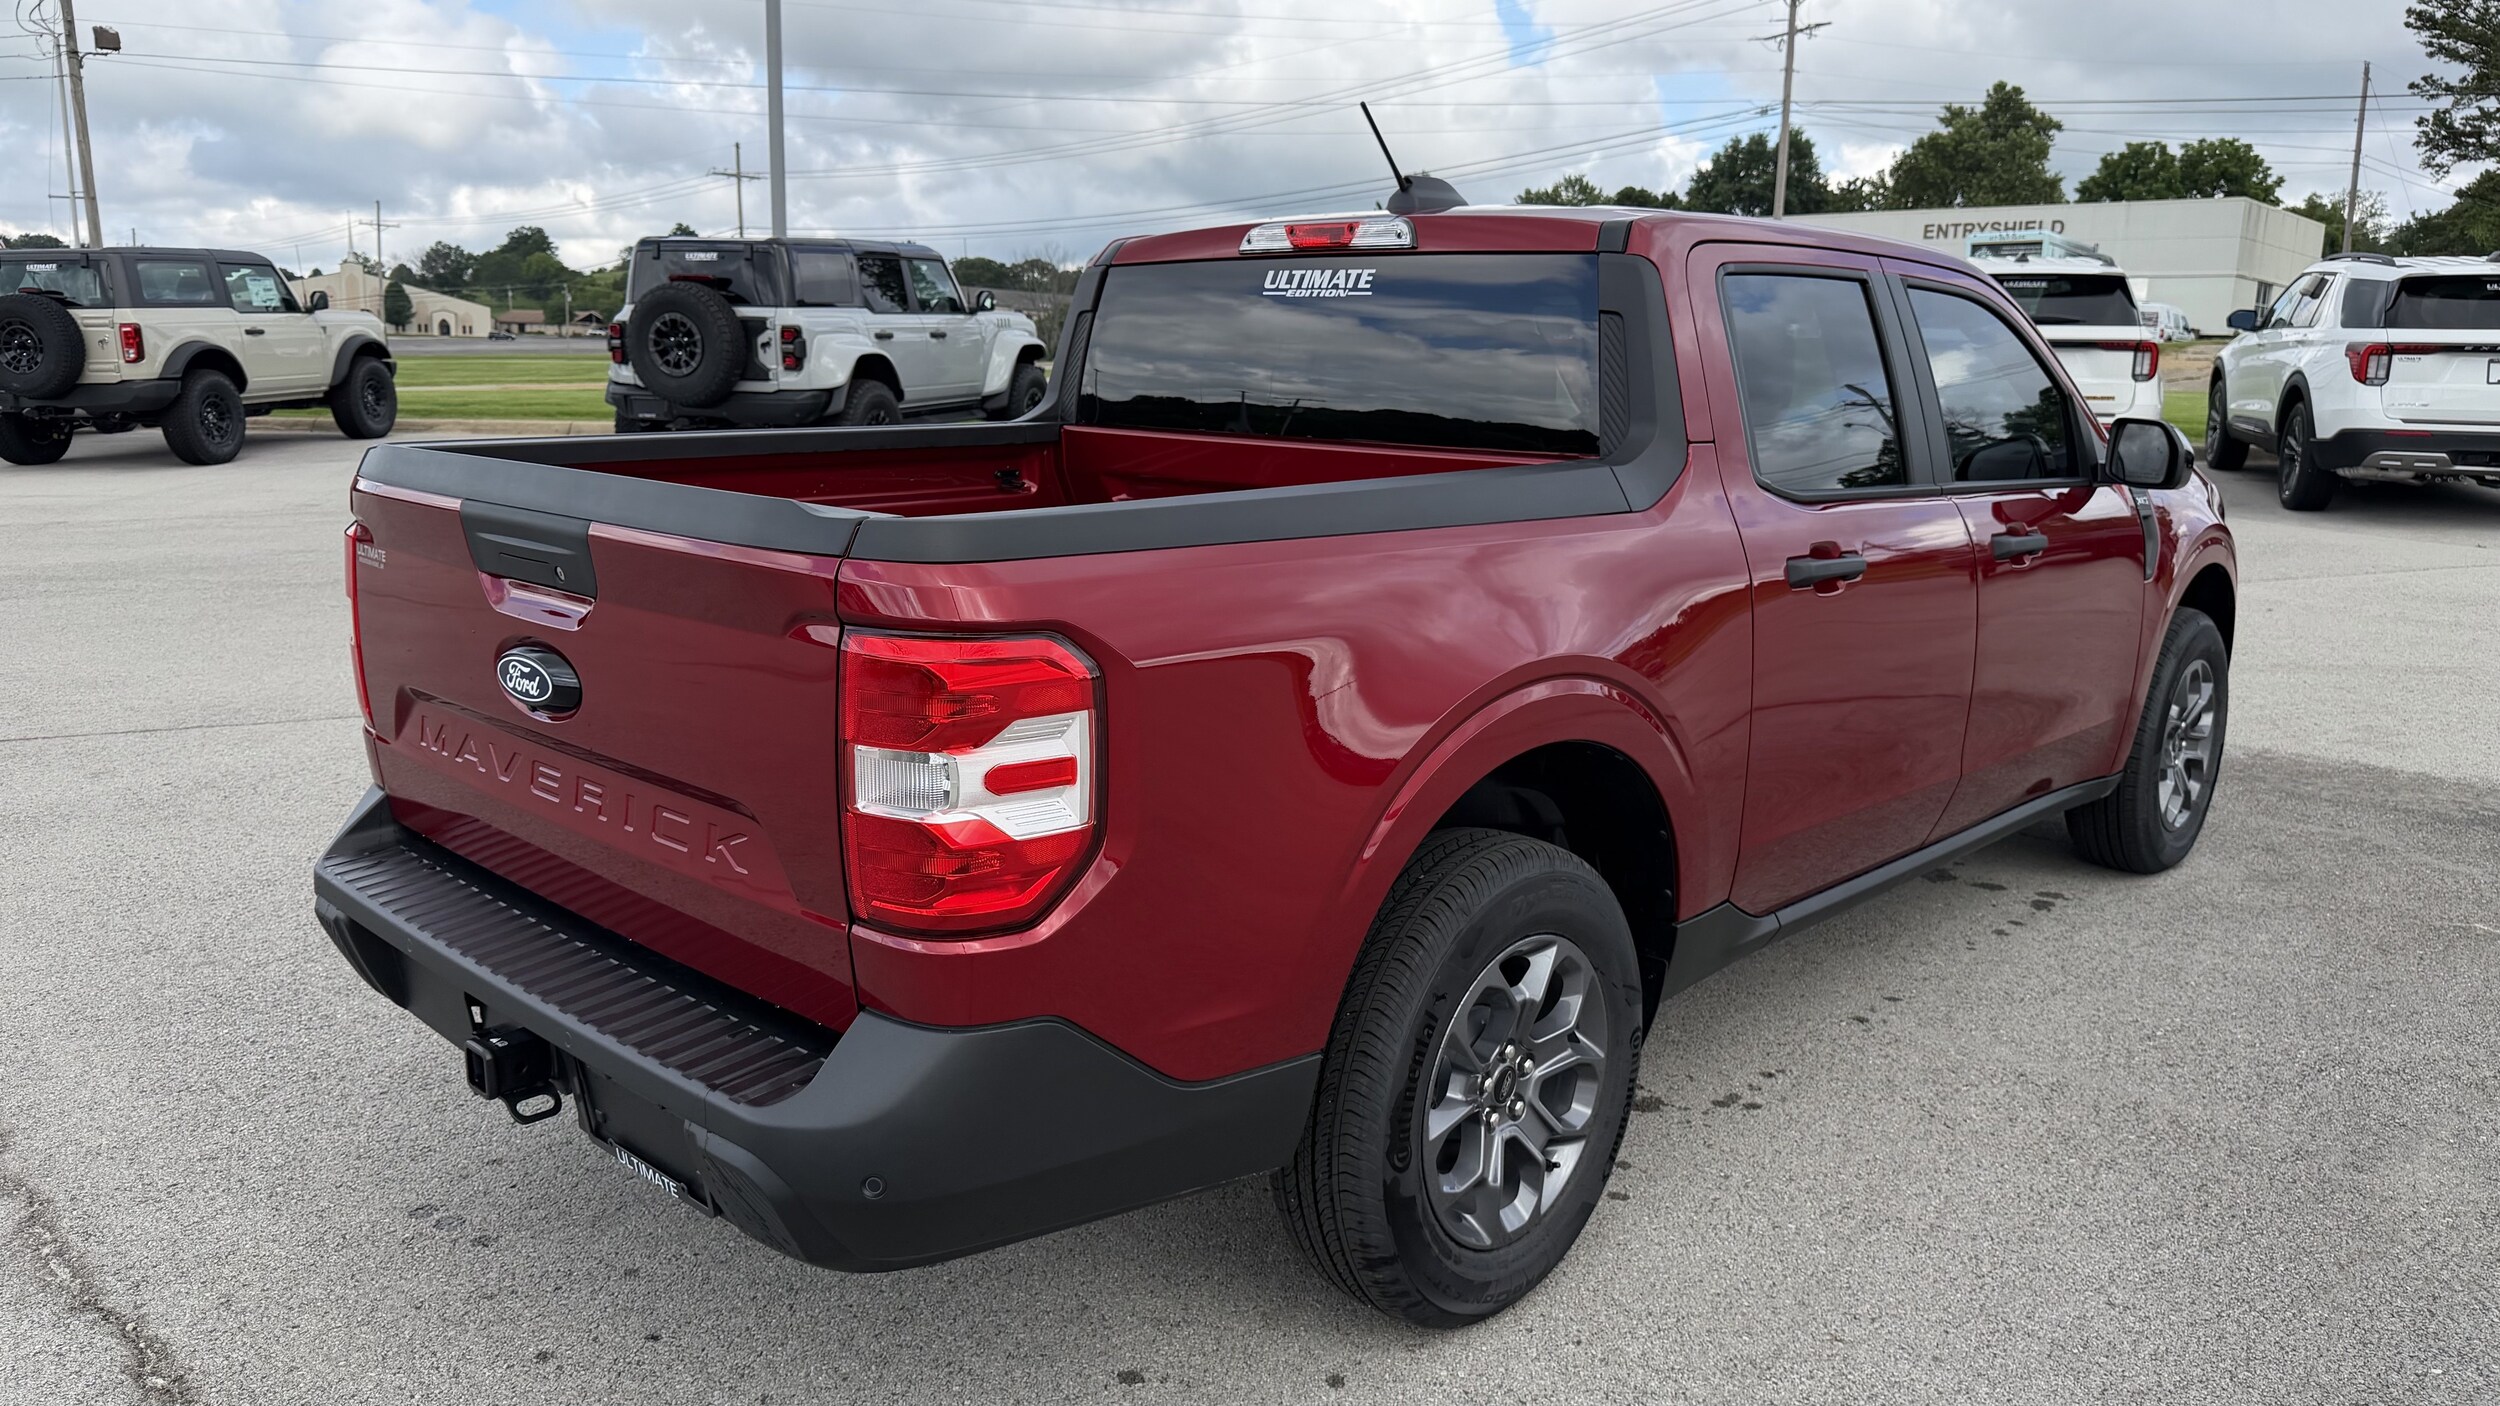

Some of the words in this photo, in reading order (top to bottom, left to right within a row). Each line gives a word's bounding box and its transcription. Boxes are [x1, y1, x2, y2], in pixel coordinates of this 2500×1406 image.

[1263, 269, 1376, 289] ULTIMATE
[1285, 289, 1349, 298] EDITION
[357, 542, 387, 563] ULTIMATE
[506, 661, 540, 697] Ford
[420, 714, 749, 875] MAVERICK
[615, 1147, 680, 1199] ULTIMATE
